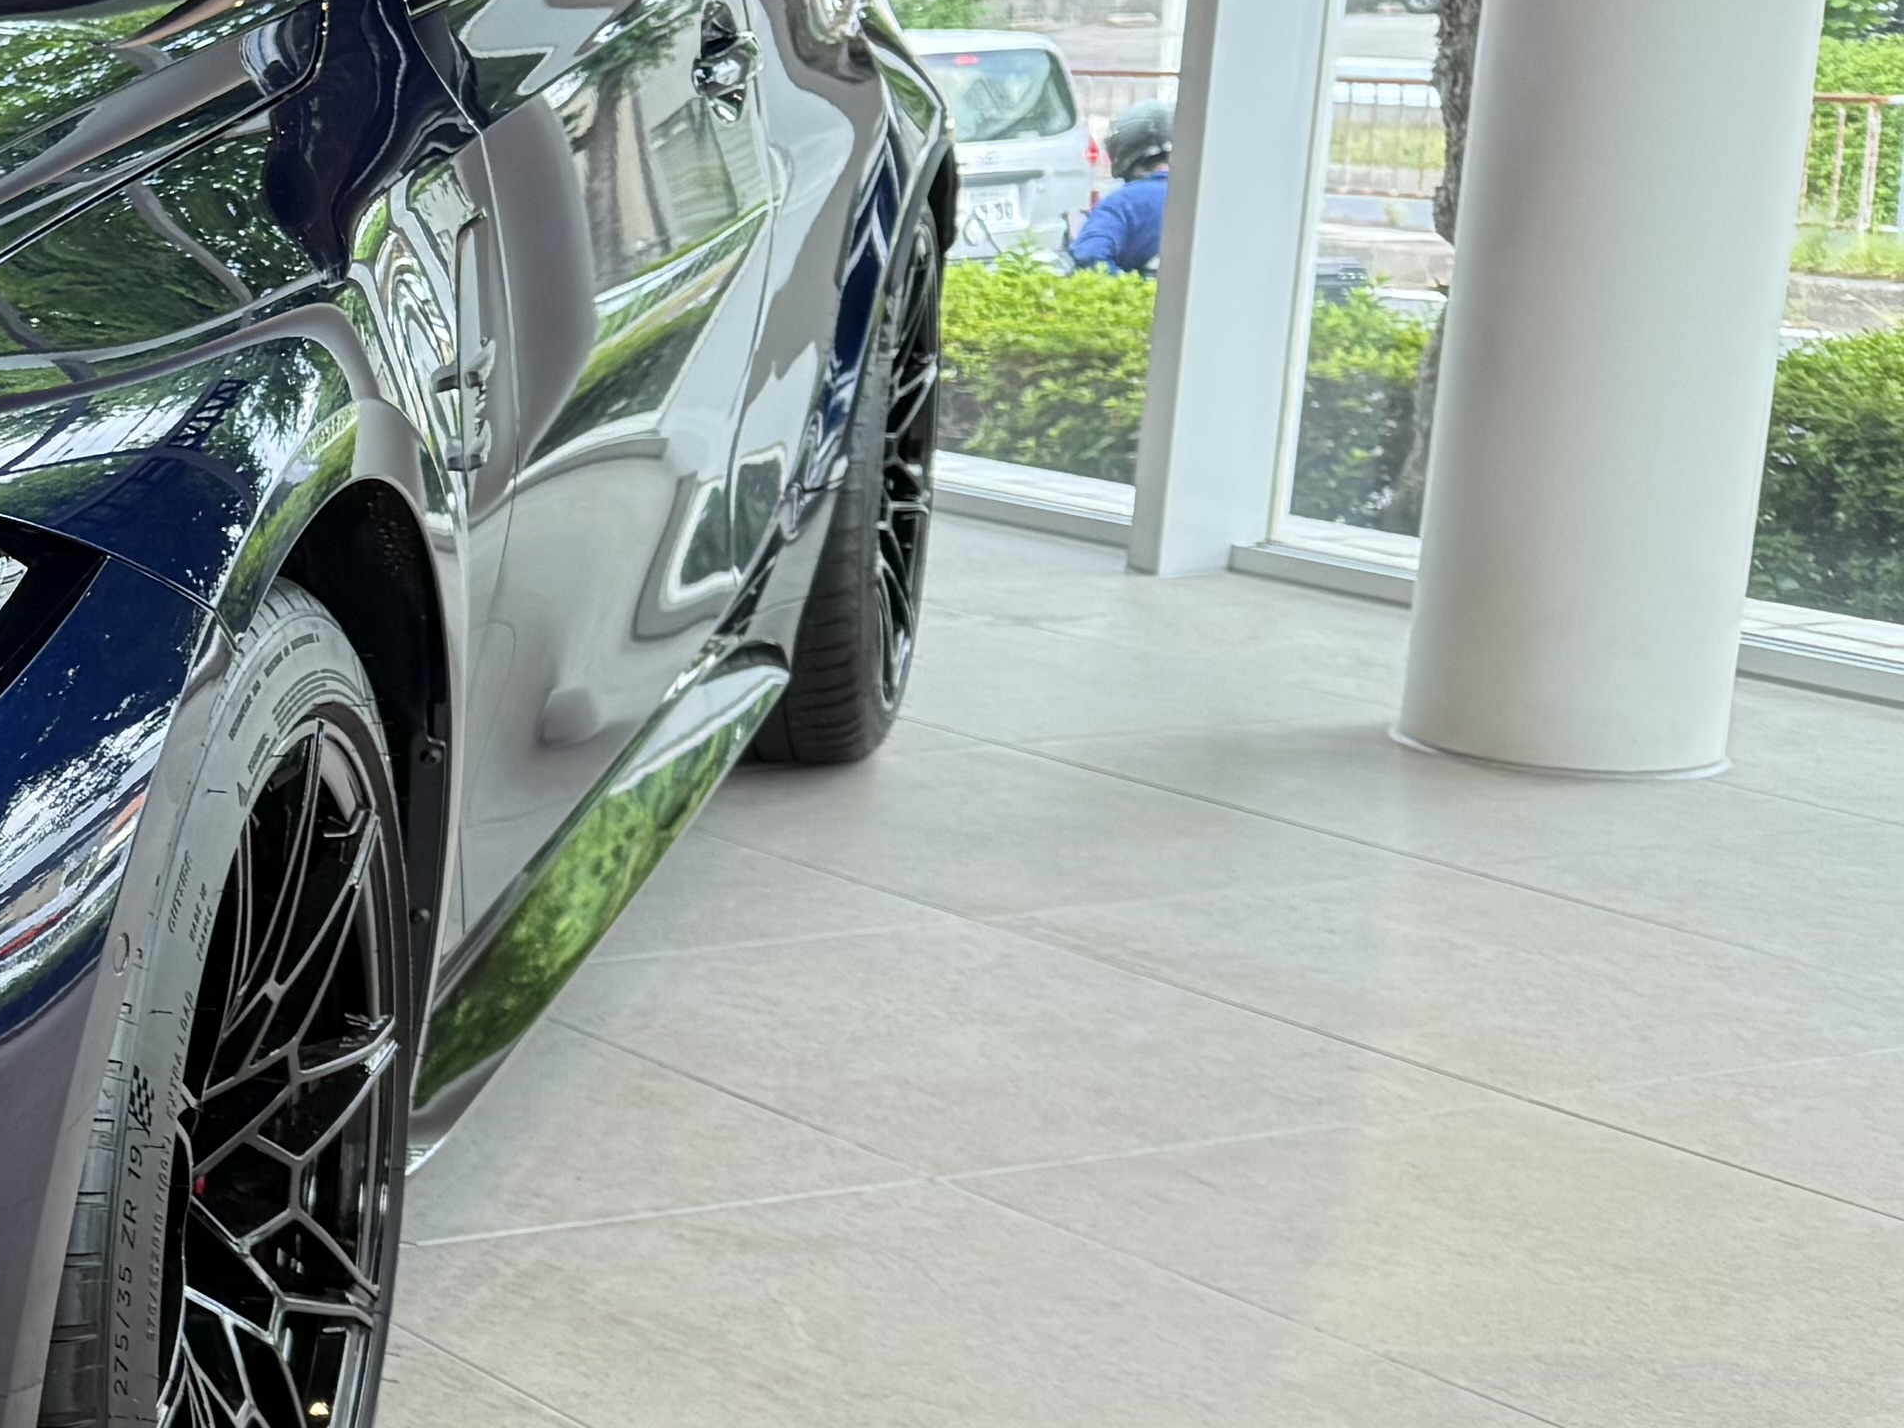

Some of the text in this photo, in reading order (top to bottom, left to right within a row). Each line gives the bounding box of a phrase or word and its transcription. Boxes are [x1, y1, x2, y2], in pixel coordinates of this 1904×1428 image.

[113, 1144, 143, 1397] 275/35 ZR 19
